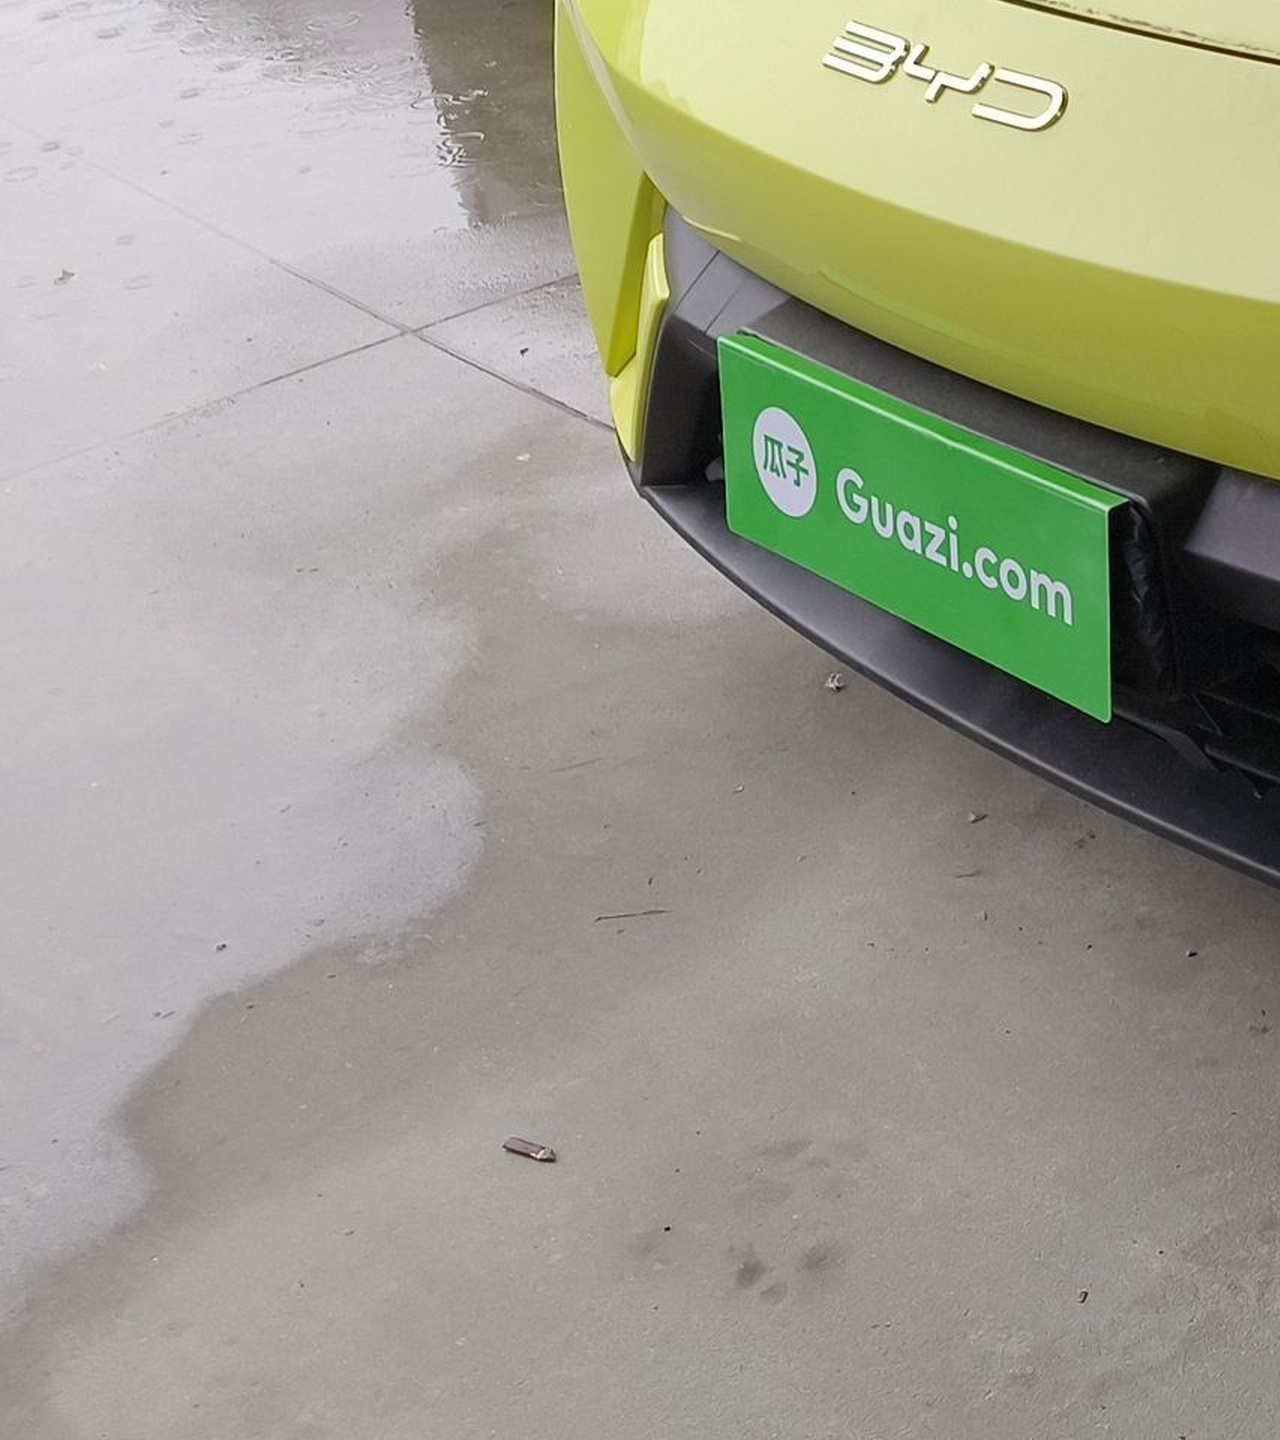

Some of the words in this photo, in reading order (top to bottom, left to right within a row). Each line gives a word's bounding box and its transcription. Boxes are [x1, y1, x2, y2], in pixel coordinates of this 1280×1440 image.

[822, 20, 1068, 131] BYD
[763, 434, 809, 487] 瓜子
[836, 467, 1072, 626] Guazi.com
